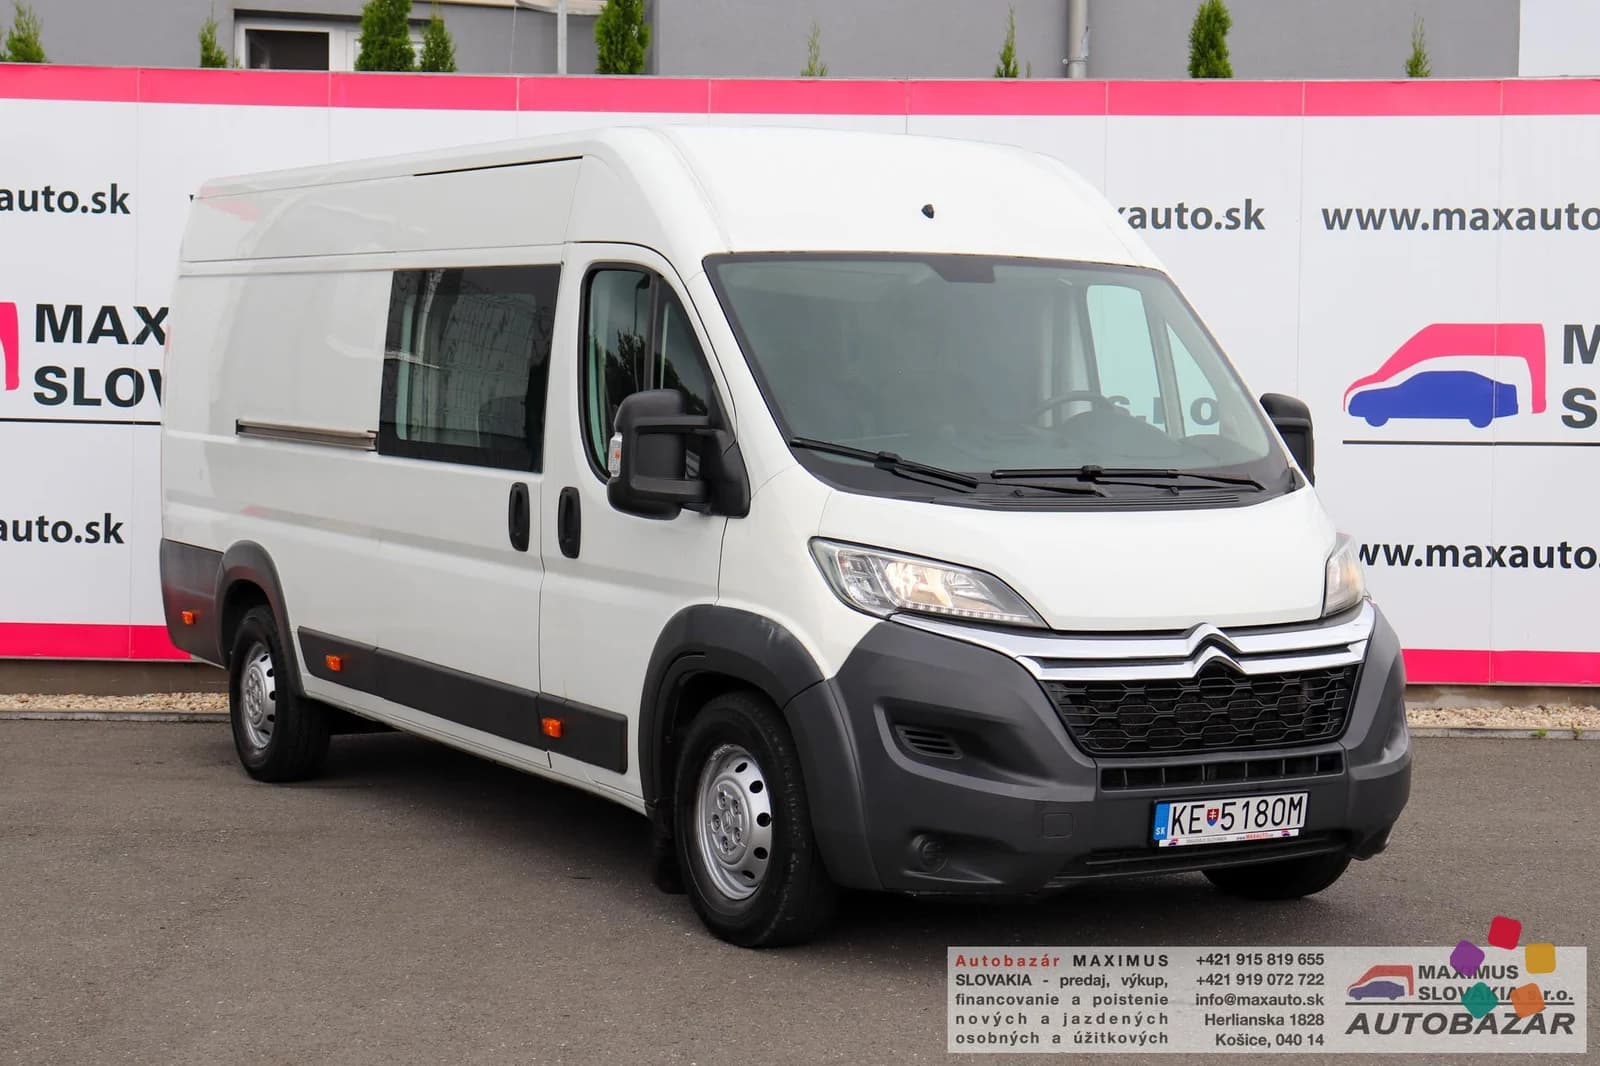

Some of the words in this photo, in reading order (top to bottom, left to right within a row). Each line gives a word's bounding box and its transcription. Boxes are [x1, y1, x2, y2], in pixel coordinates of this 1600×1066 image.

[1118, 198, 1265, 230] auto.sk
[35, 303, 169, 346] MAX
[1359, 541, 1600, 570] ww.maxauto
[1155, 827, 1165, 835] SK
[1171, 804, 1205, 836] KE
